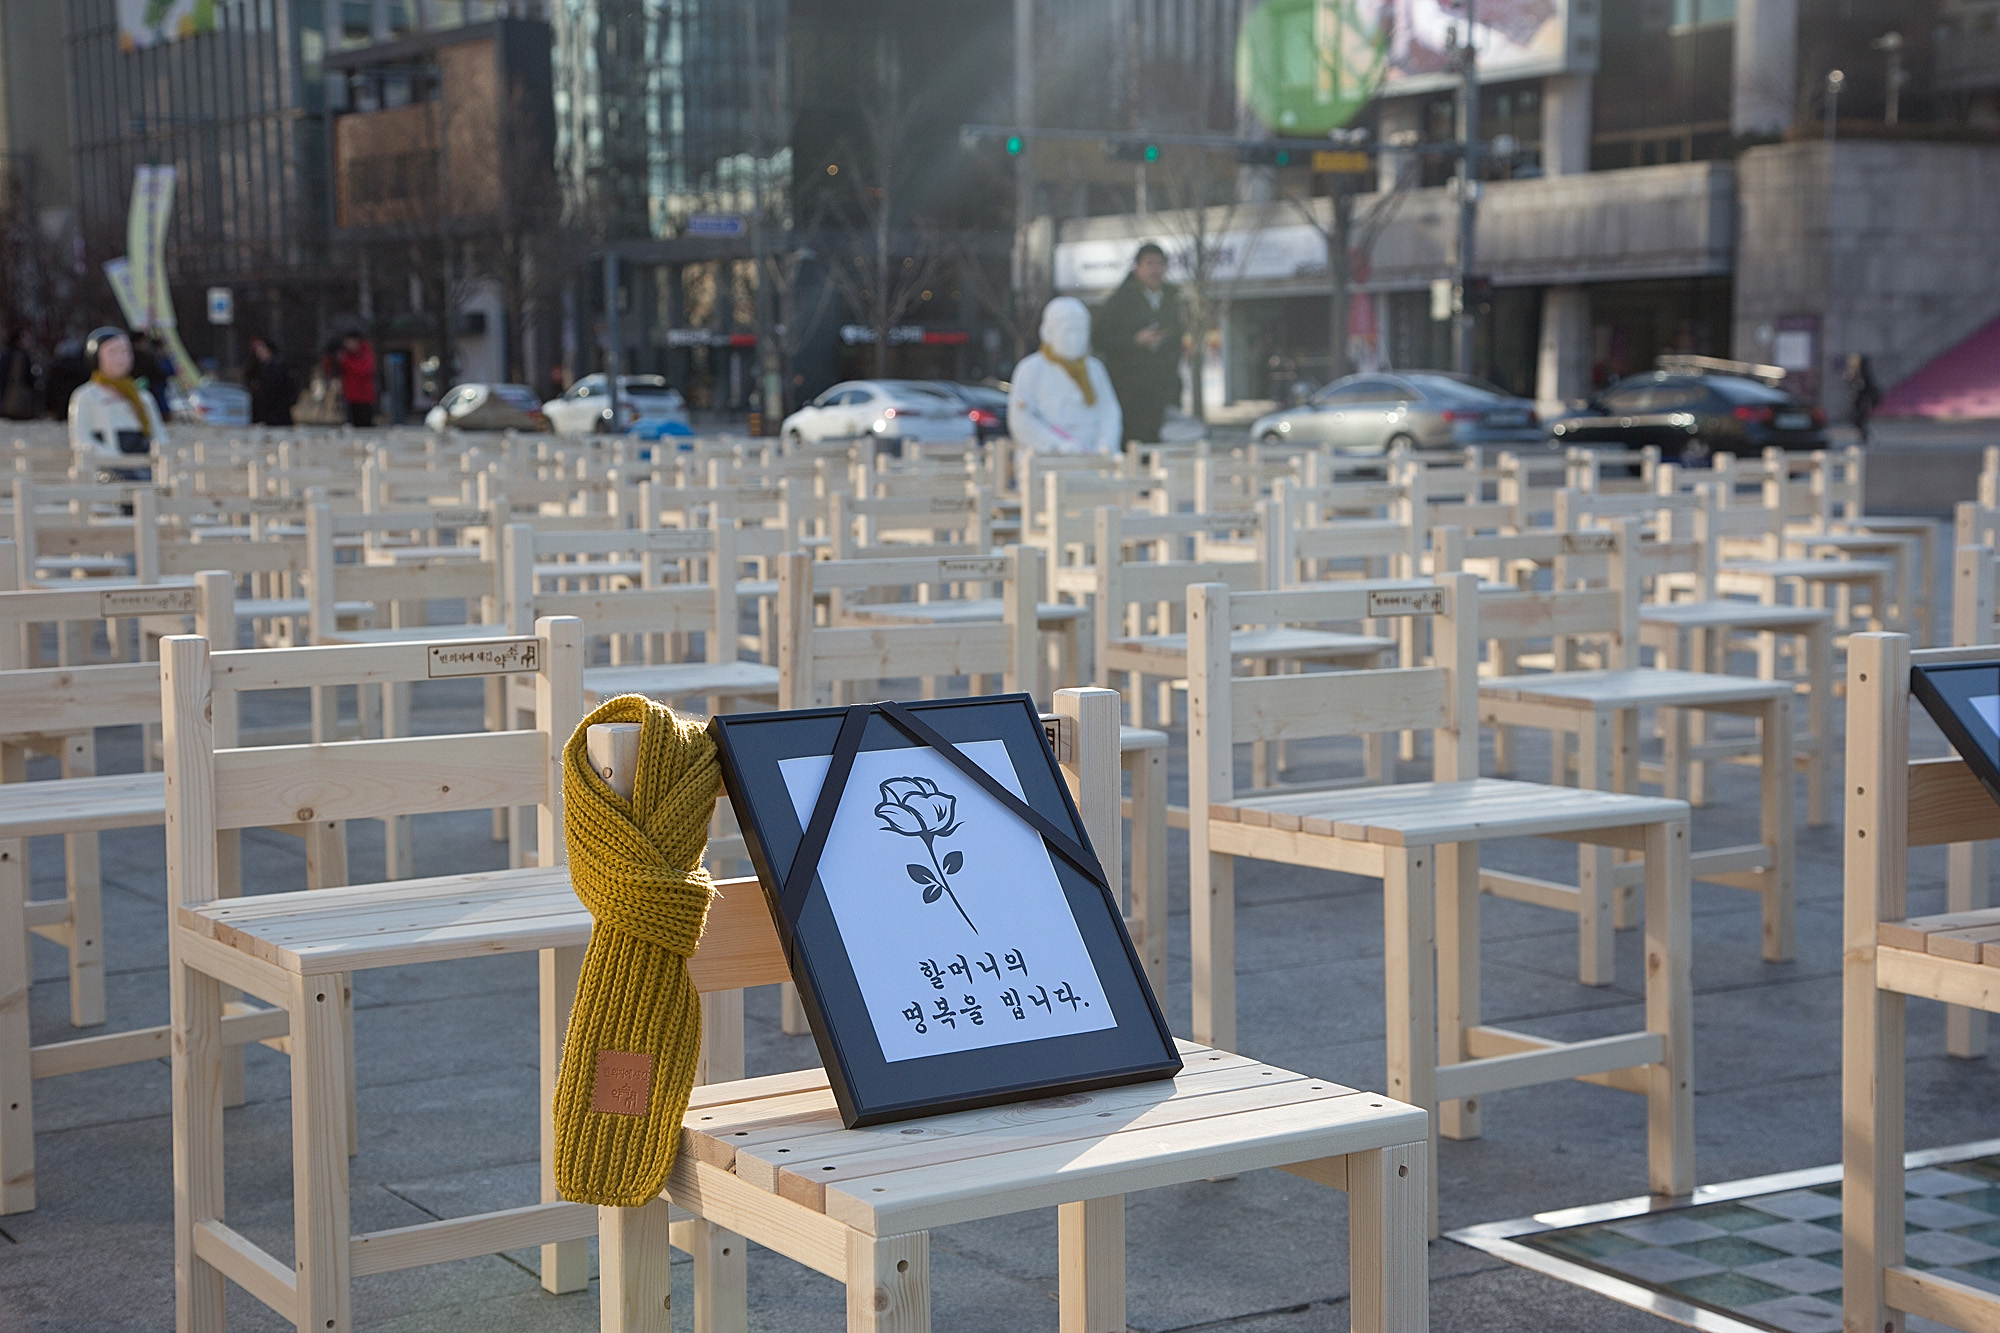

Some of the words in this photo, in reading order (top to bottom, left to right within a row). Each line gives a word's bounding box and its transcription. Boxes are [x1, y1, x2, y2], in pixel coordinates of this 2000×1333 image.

[449, 652, 474, 663] 의자에
[494, 643, 519, 669] 약속
[919, 948, 1028, 990] 할머니의
[902, 994, 984, 1035] 명복을
[1000, 981, 1090, 1021] 빕니다.
[611, 1067, 633, 1080] 의자에
[612, 1083, 632, 1102] 약속
